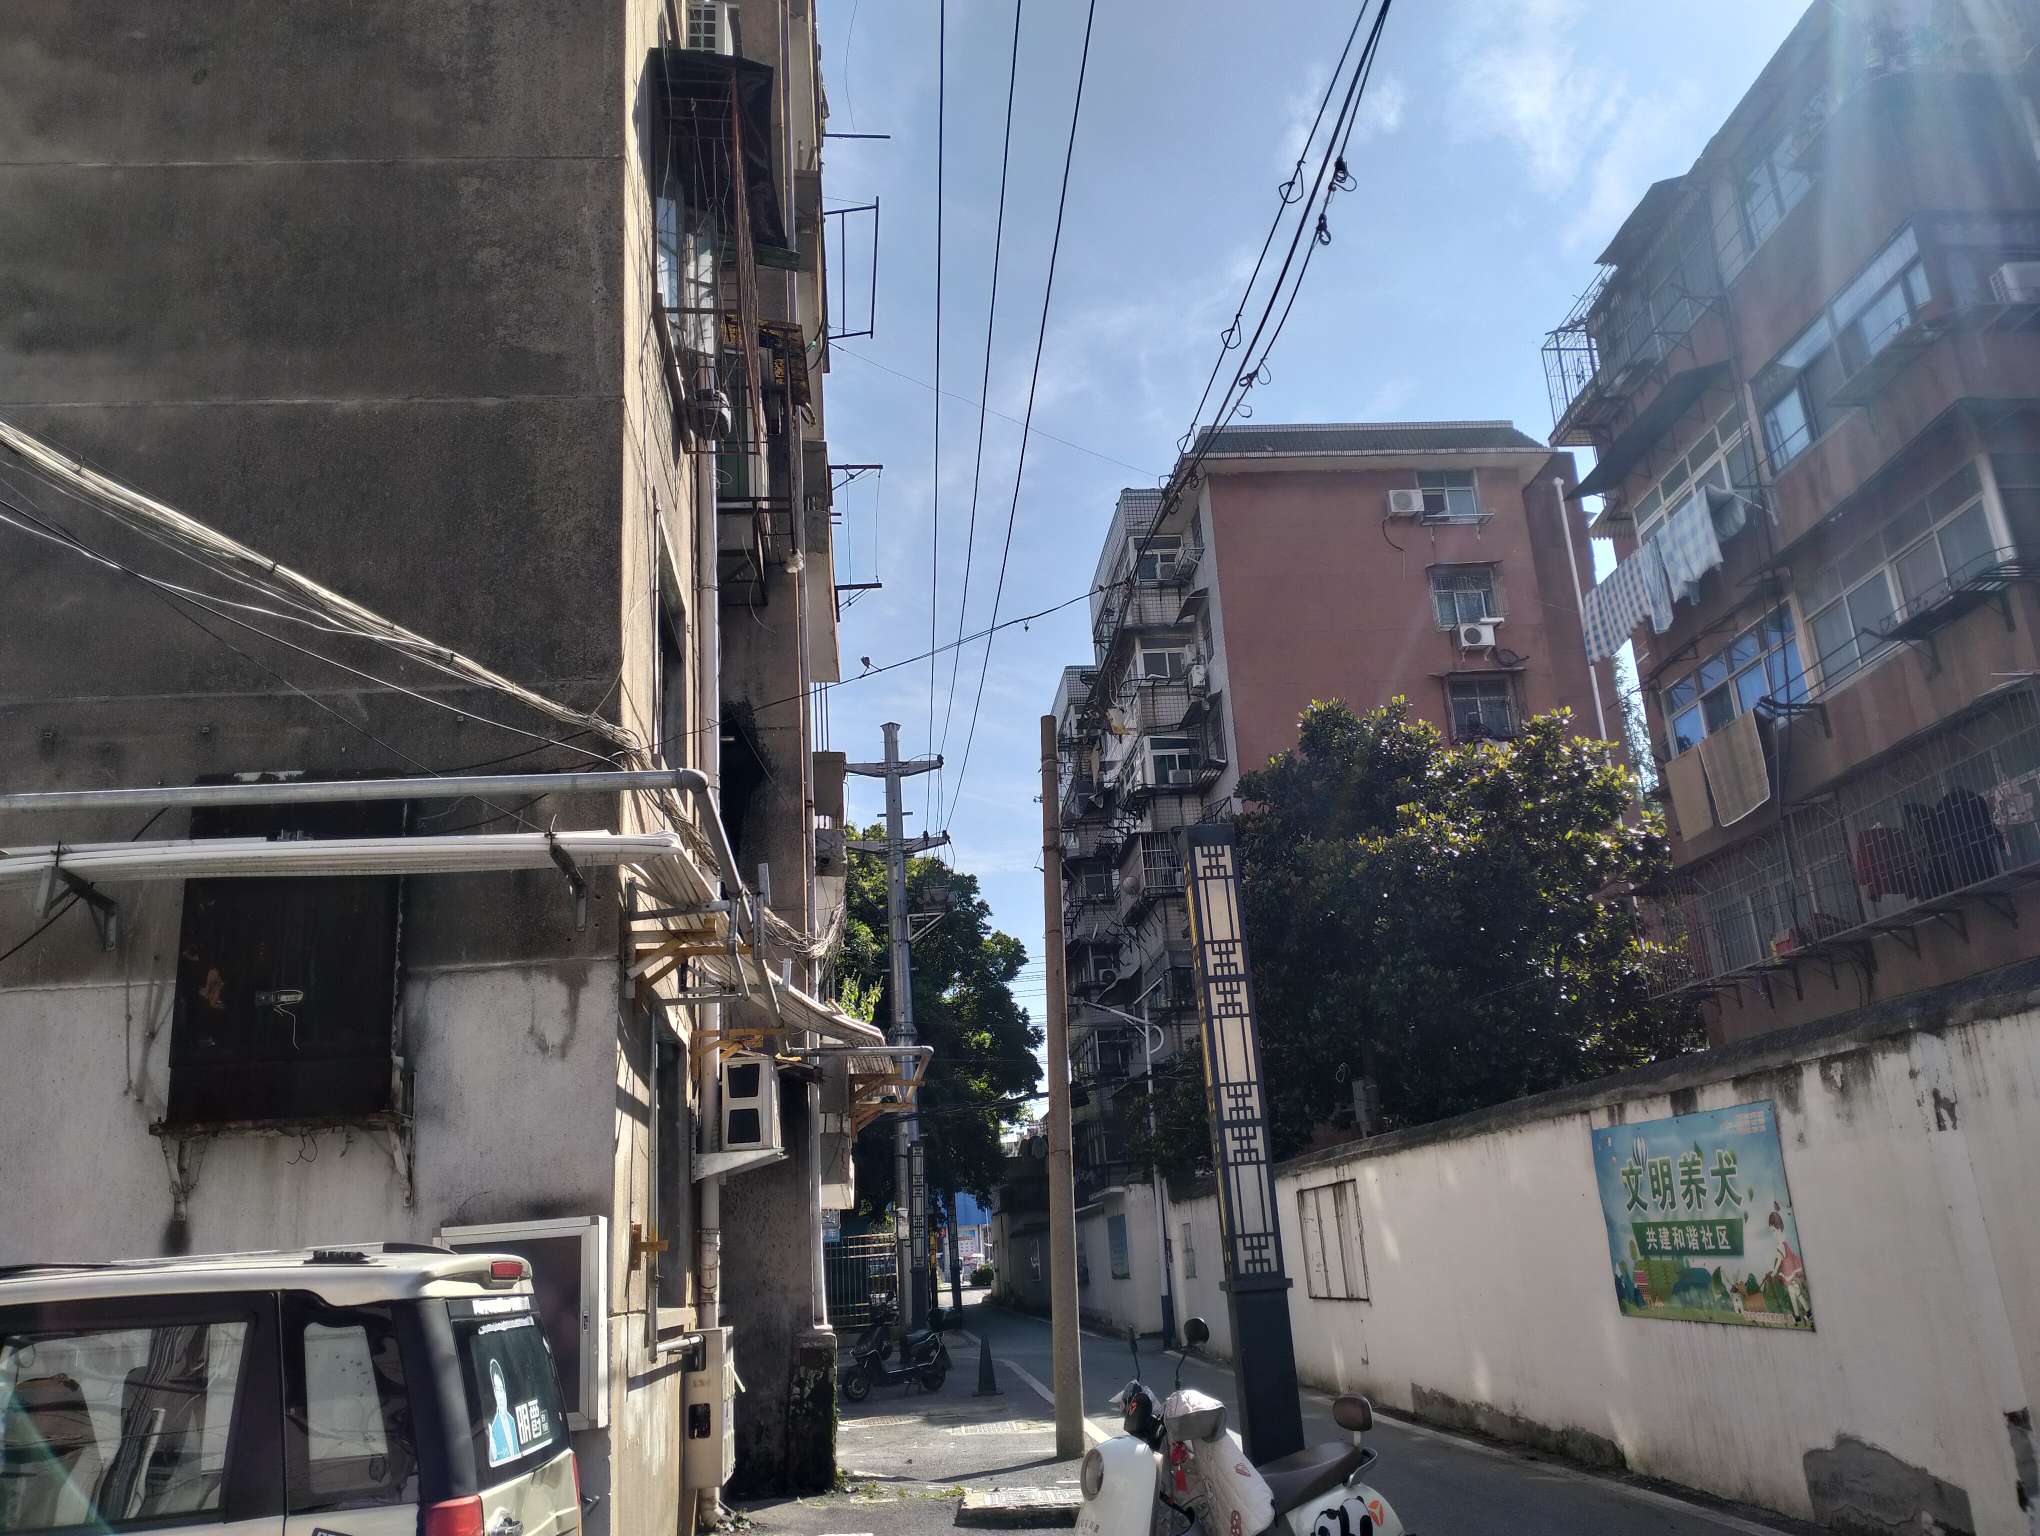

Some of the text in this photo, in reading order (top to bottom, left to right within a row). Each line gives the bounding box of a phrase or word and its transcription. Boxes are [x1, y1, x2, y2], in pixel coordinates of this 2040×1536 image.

[1620, 1151, 1743, 1213] 文明养犬
[1645, 1224, 1731, 1251] 共建和谐社区
